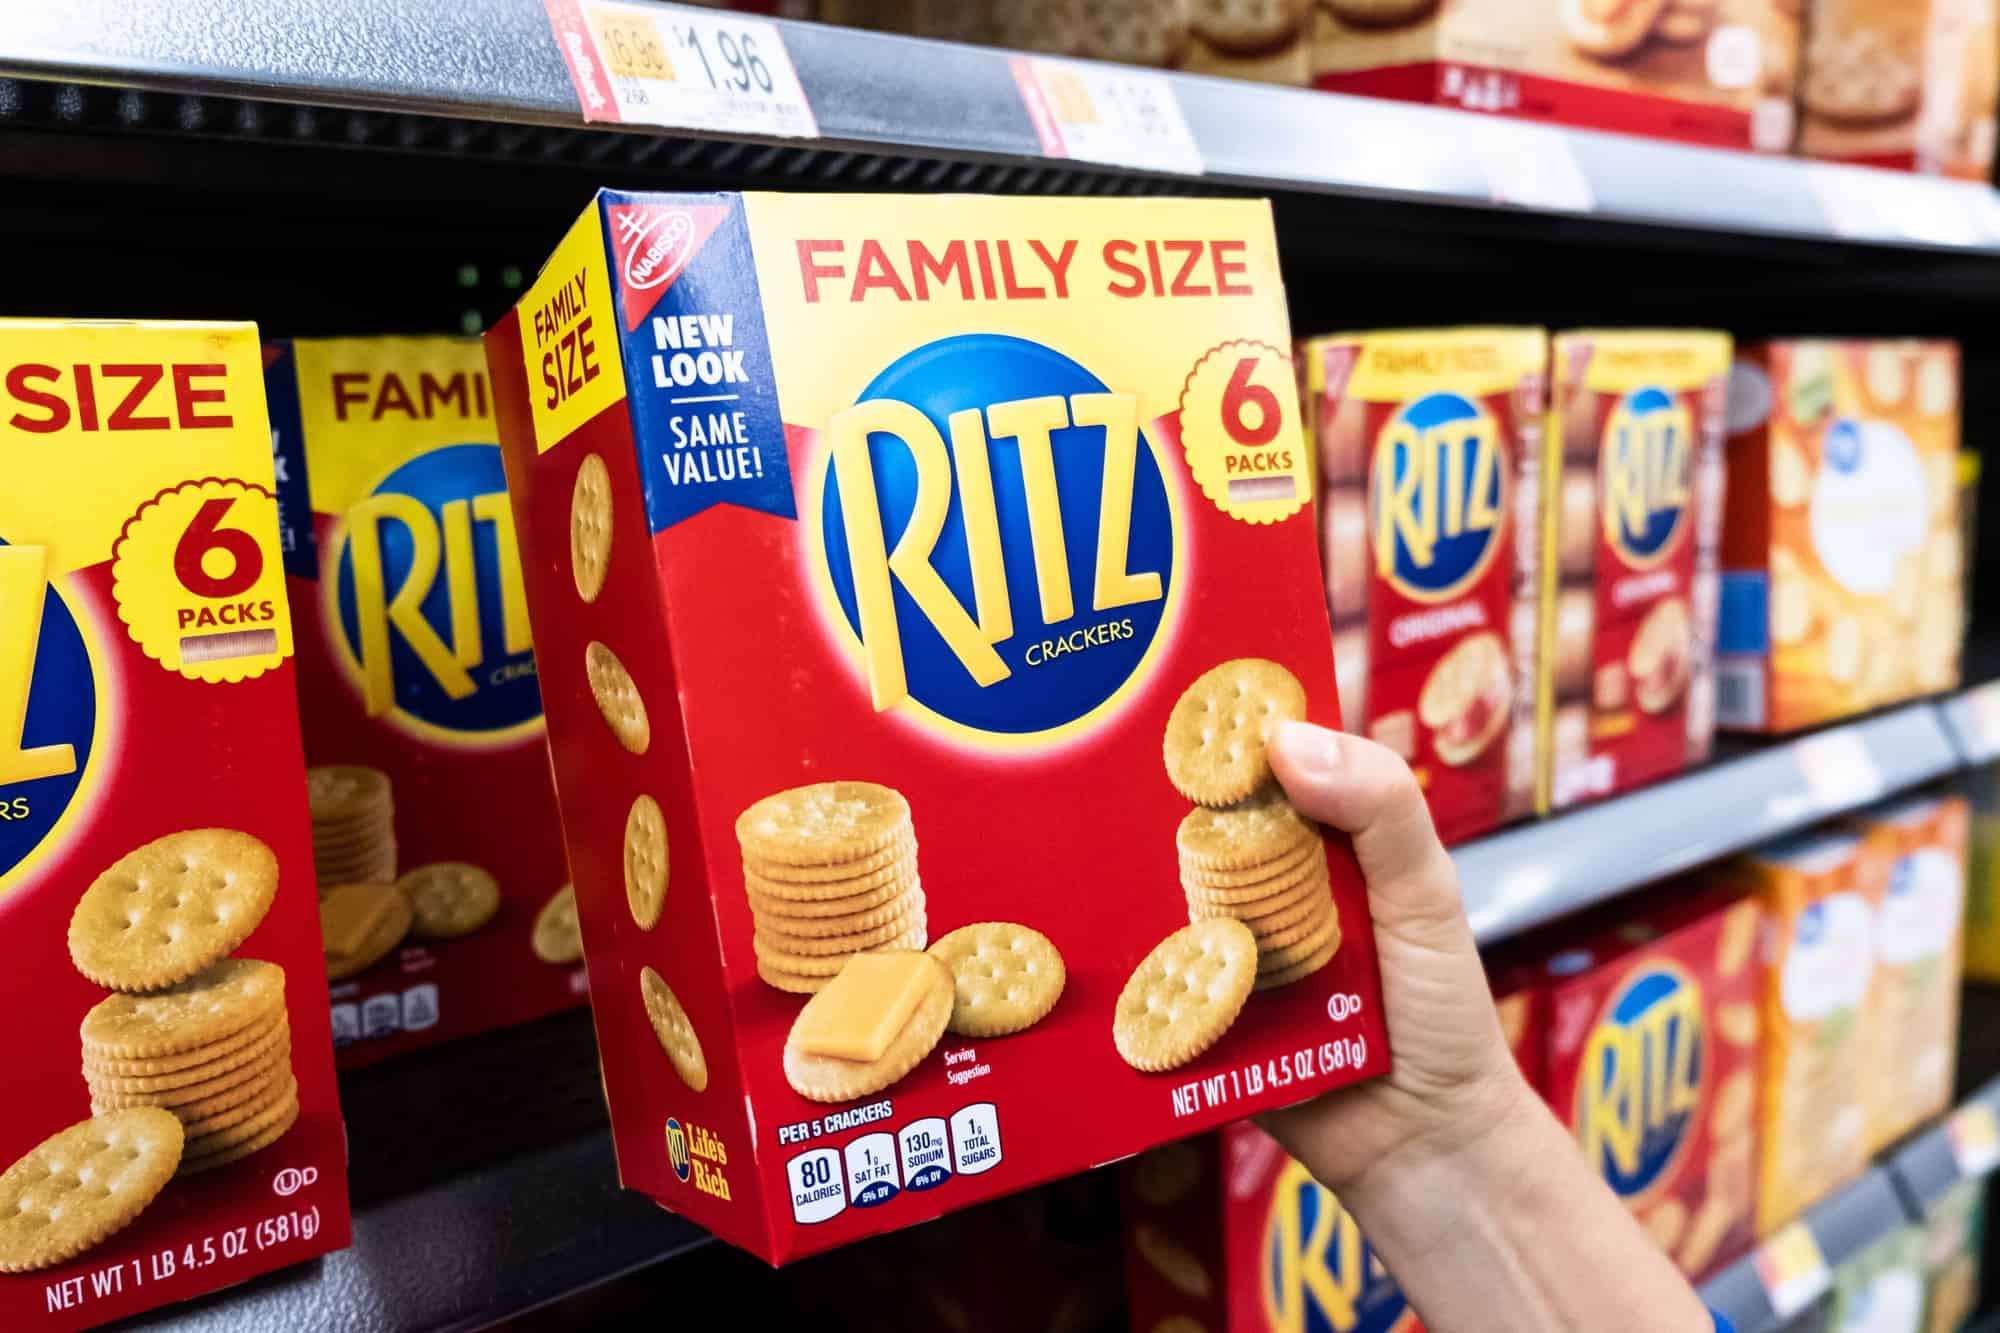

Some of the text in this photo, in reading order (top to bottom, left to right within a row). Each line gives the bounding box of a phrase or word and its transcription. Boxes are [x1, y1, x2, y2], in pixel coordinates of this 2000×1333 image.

[630, 215, 689, 284] NABISCO
[794, 238, 1254, 303] FAMILY SIZE
[534, 266, 588, 349] FAMILY
[652, 314, 733, 350] NEW
[542, 315, 601, 411] SIZE
[651, 350, 750, 389] LOOK
[4, 363, 235, 434] SIZE
[331, 372, 488, 422] FAMI
[1220, 357, 1282, 448] 6
[669, 411, 749, 450] SAME
[662, 446, 764, 486] VALUE!
[1225, 451, 1294, 474] PACKS
[1603, 409, 1691, 543] RITZ
[1375, 416, 1501, 578] RITZ
[173, 497, 263, 599] 6
[828, 392, 1163, 713] RITZ
[176, 600, 276, 630] PACKS
[346, 490, 535, 719] RIT
[1025, 619, 1135, 668] CRACKERS
[944, 1048, 976, 1066] Serving
[947, 1063, 991, 1085] Suggestion
[1171, 1034, 1367, 1118] NET WT 1 LB 4.5 OZ (581g)
[1583, 985, 1701, 1175] RITZ
[685, 1122, 728, 1165] Life's
[779, 1100, 893, 1145] PER 5 CRACKERS
[963, 1135, 991, 1151] TOTAL
[801, 1156, 831, 1188] 80
[855, 1163, 891, 1184] SAT FAT
[908, 1148, 944, 1168] SODIUM
[961, 1147, 996, 1167] SUGARS
[691, 1159, 732, 1201] Rich
[795, 1183, 842, 1207] CALORIES
[45, 1205, 321, 1313] NET WT 1 LB 4.5 OZ (581g)
